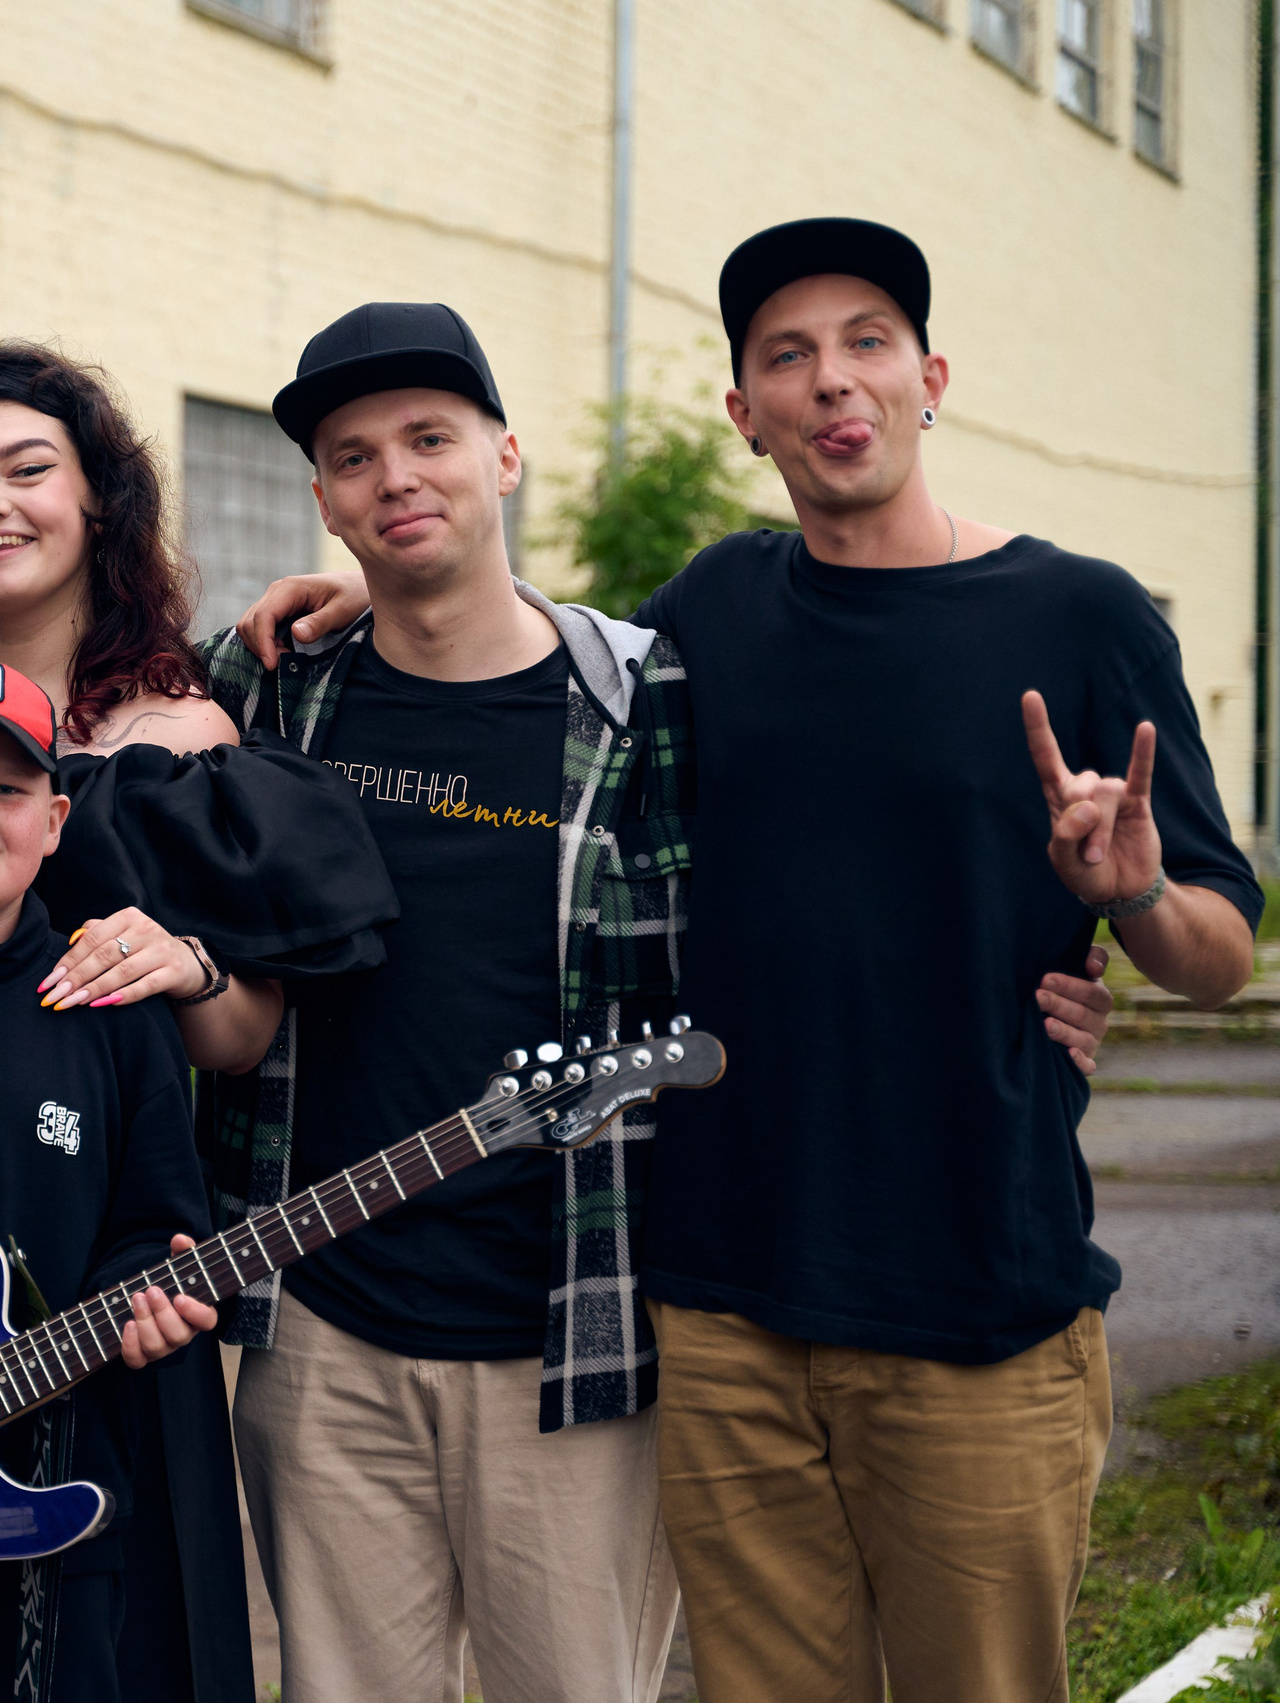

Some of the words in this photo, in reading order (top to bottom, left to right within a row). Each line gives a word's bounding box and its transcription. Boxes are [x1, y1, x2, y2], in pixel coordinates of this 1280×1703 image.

[321, 759, 469, 808] ЕРШЕННО
[429, 799, 560, 828] летни
[618, 1088, 652, 1103] DELUXE
[54, 1106, 67, 1147] BRAVE
